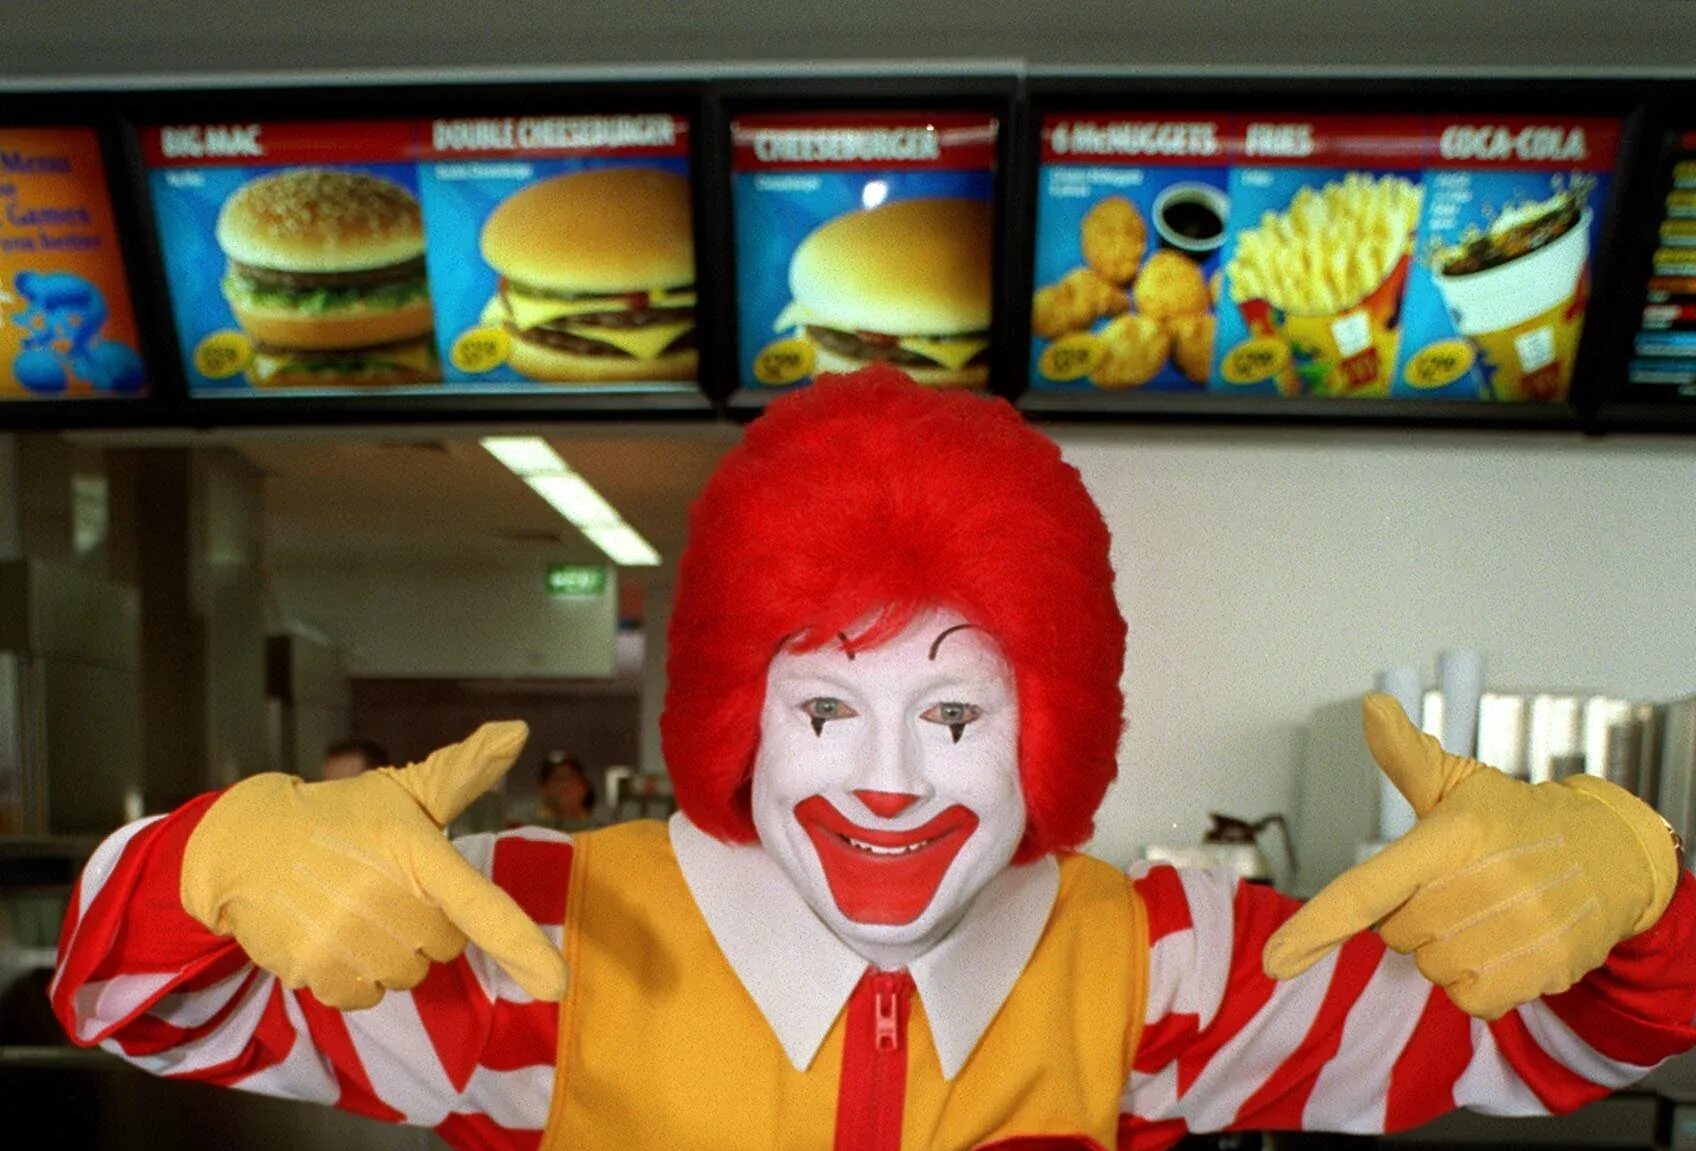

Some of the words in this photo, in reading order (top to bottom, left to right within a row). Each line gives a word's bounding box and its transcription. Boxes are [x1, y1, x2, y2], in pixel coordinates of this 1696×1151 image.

[433, 118, 515, 151] DOUBLE
[517, 115, 676, 149] CHEESEBURGER
[754, 129, 940, 161] CHEESEBURGER
[1440, 126, 1588, 161] COCA-COLA
